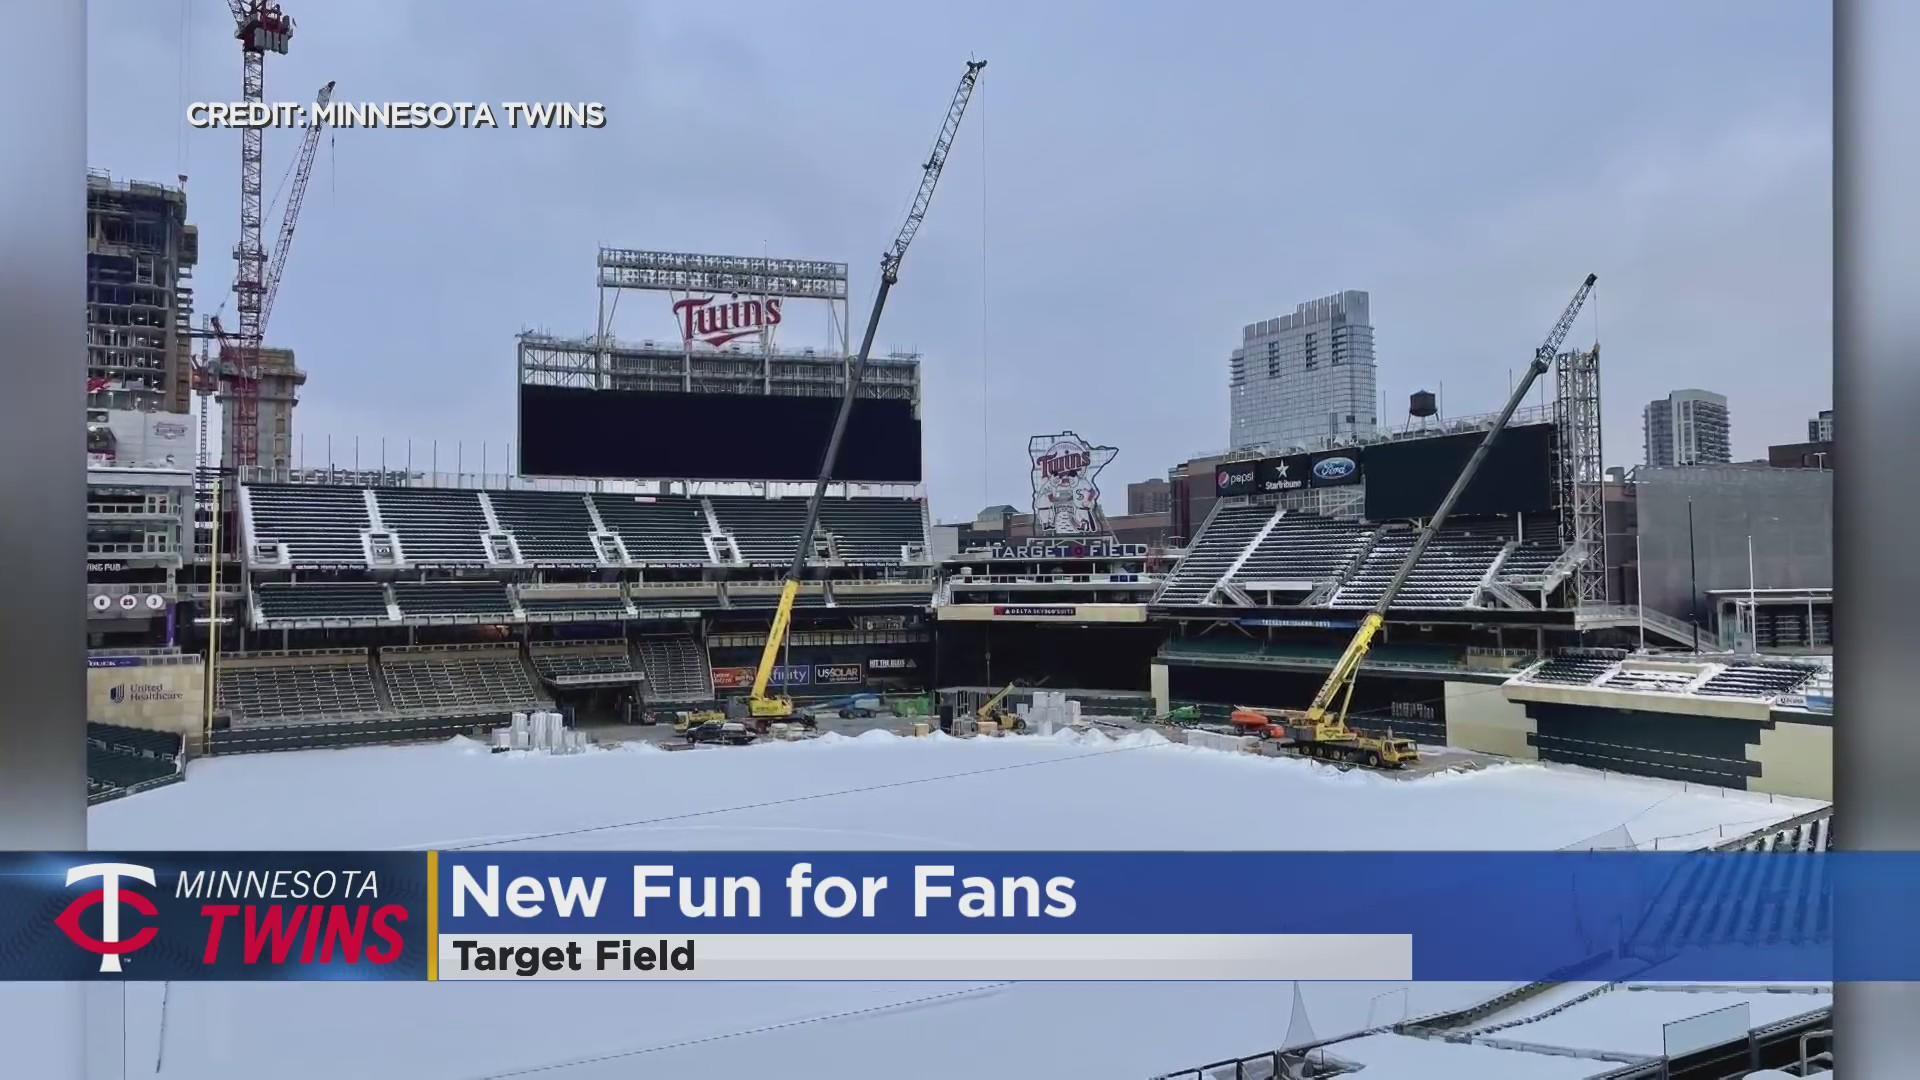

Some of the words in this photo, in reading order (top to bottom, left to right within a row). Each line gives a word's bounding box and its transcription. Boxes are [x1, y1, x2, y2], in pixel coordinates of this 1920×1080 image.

[673, 292, 781, 341] Twins
[1036, 449, 1091, 480] Twins
[1320, 462, 1347, 476] Ford
[1229, 471, 1255, 486] pepsi
[992, 545, 1069, 559] TARGET
[1089, 543, 1149, 557] FIELD
[768, 668, 807, 684] finity
[130, 683, 163, 692] United
[130, 691, 184, 701] Healthcare
